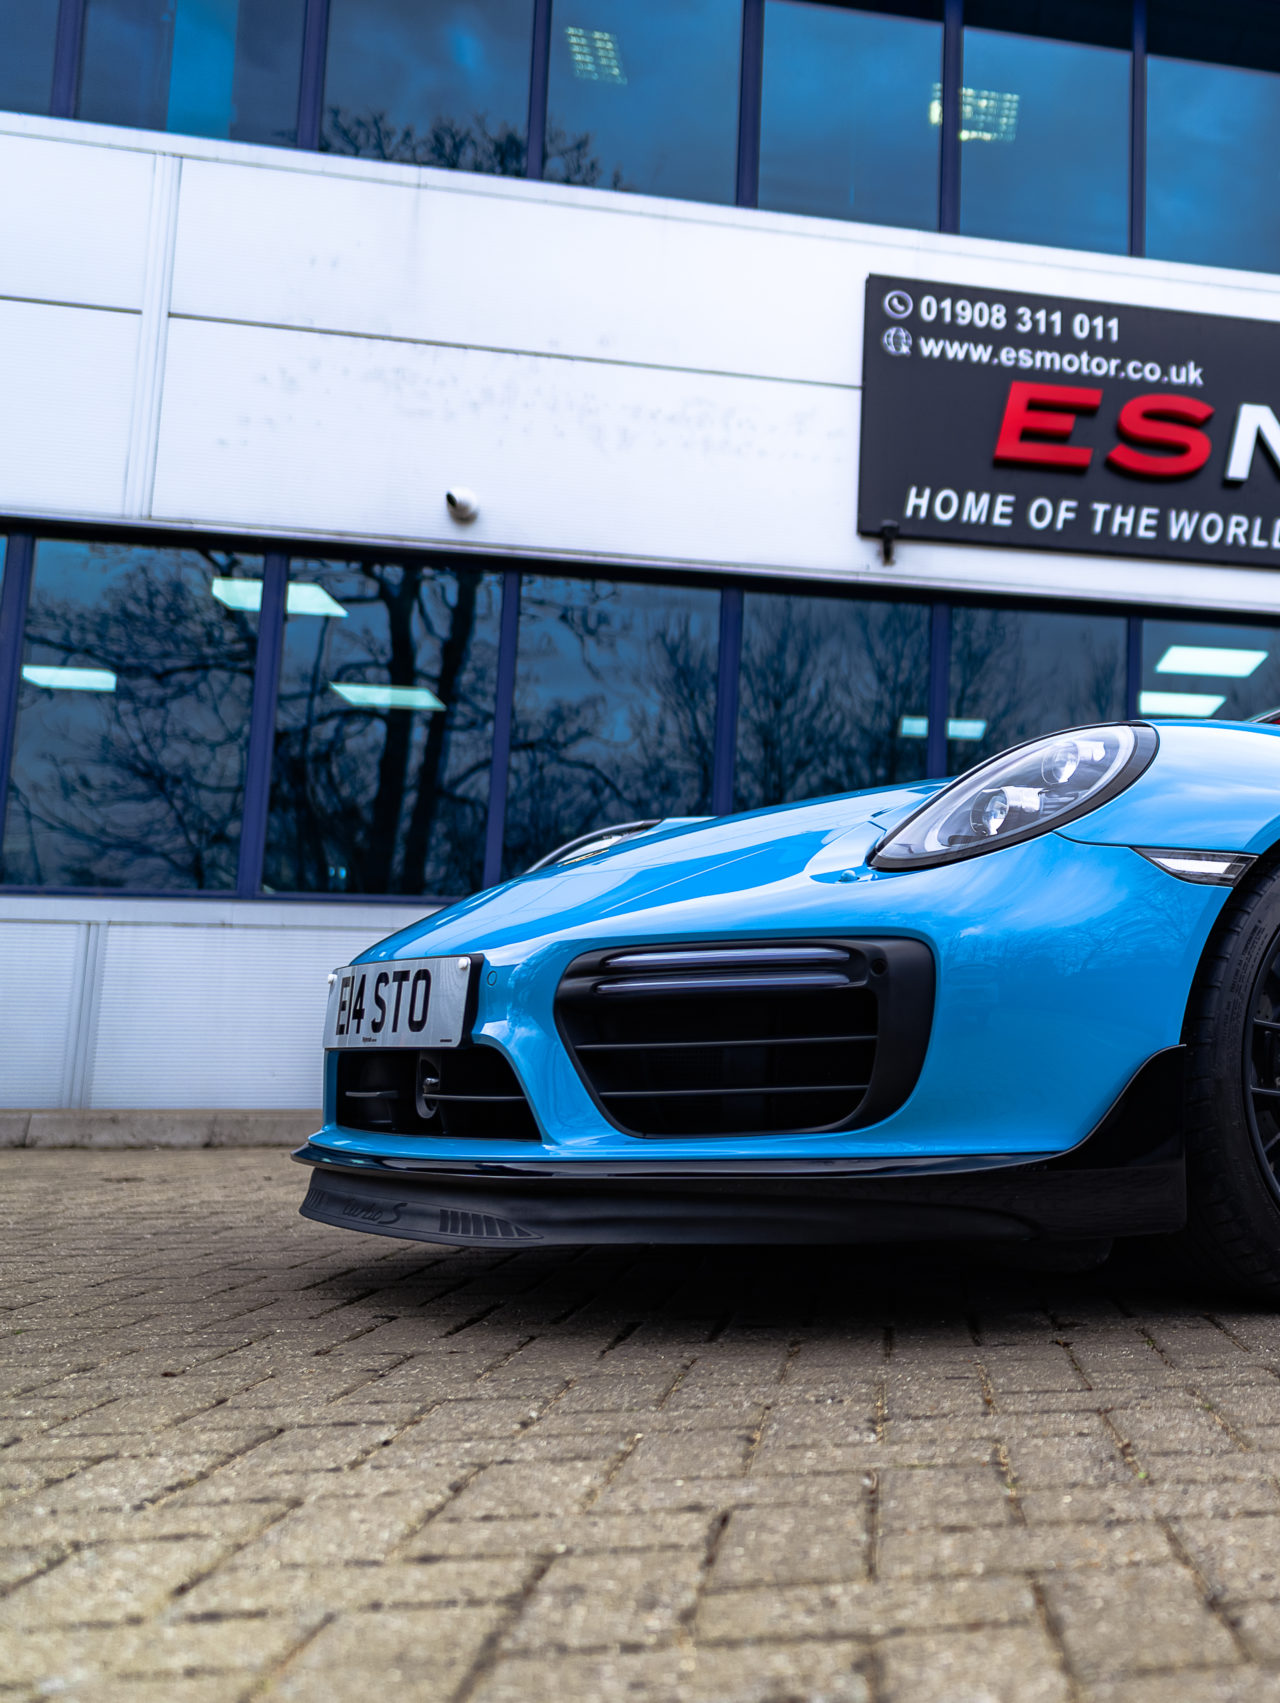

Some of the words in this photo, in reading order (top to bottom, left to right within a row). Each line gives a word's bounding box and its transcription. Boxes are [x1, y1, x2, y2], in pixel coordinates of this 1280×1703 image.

[919, 295, 1007, 330] 01908
[1015, 306, 1062, 337] 311
[1072, 313, 1119, 343] 011
[919, 336, 1204, 386] www.esmotor.co.uk
[905, 486, 1016, 527] HOME
[1028, 497, 1078, 531] OF
[1090, 502, 1160, 538] THE
[335, 974, 366, 1035] E14
[371, 968, 432, 1033] STO
[342, 1198, 383, 1221] turbo
[377, 1202, 408, 1224] S
